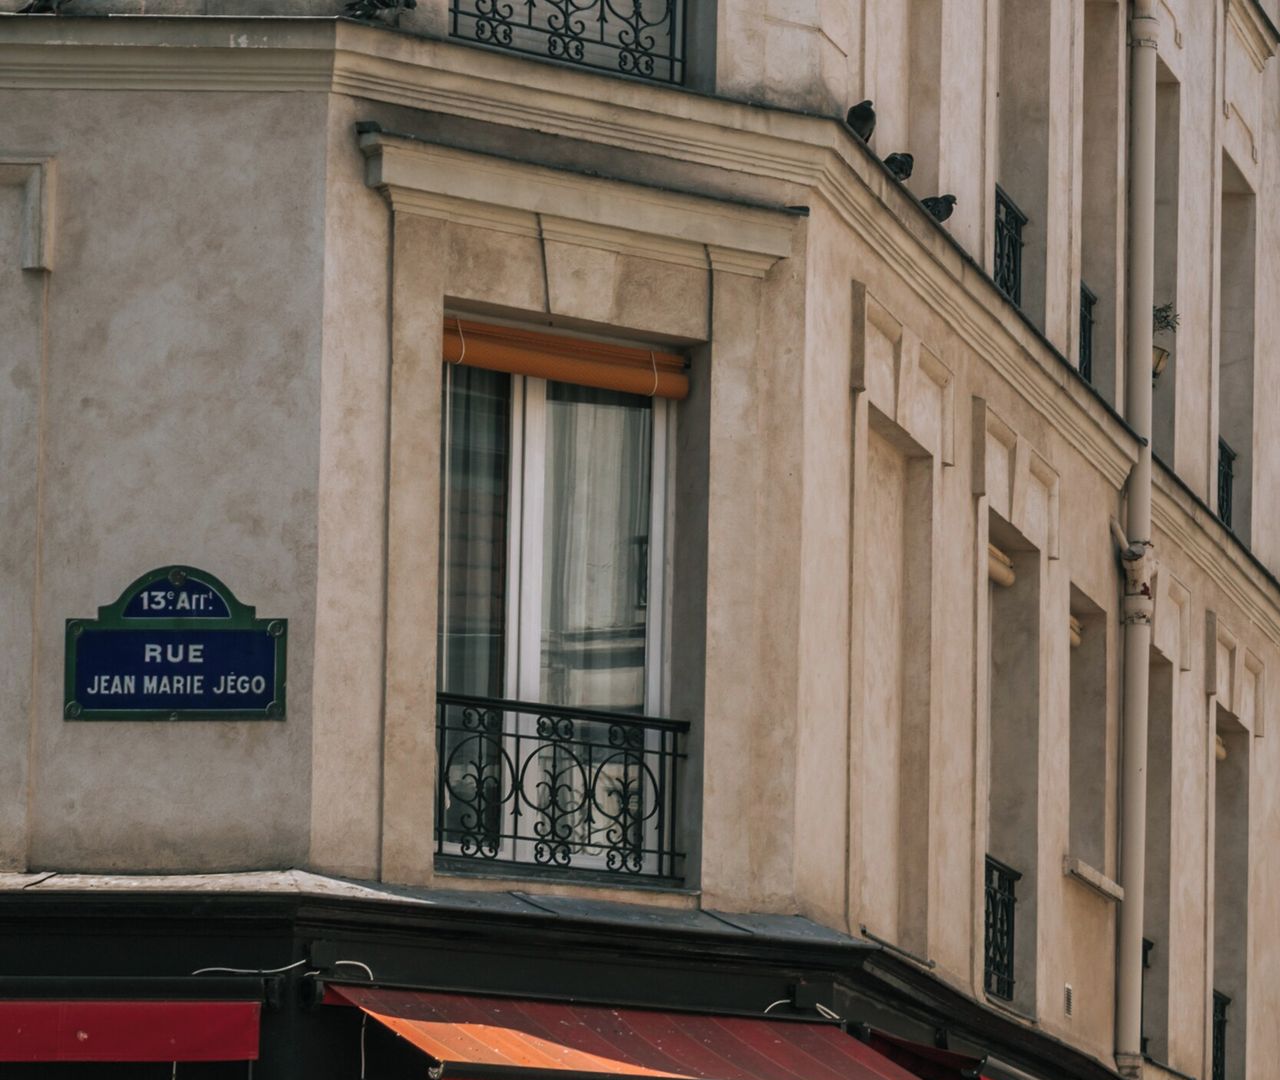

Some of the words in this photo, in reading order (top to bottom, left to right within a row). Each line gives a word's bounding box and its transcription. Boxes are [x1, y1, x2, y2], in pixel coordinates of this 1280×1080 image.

[144, 644, 205, 663] RUE
[87, 675, 135, 694] JEAN
[143, 675, 204, 694] MARIE
[213, 671, 266, 694] JÉGO
